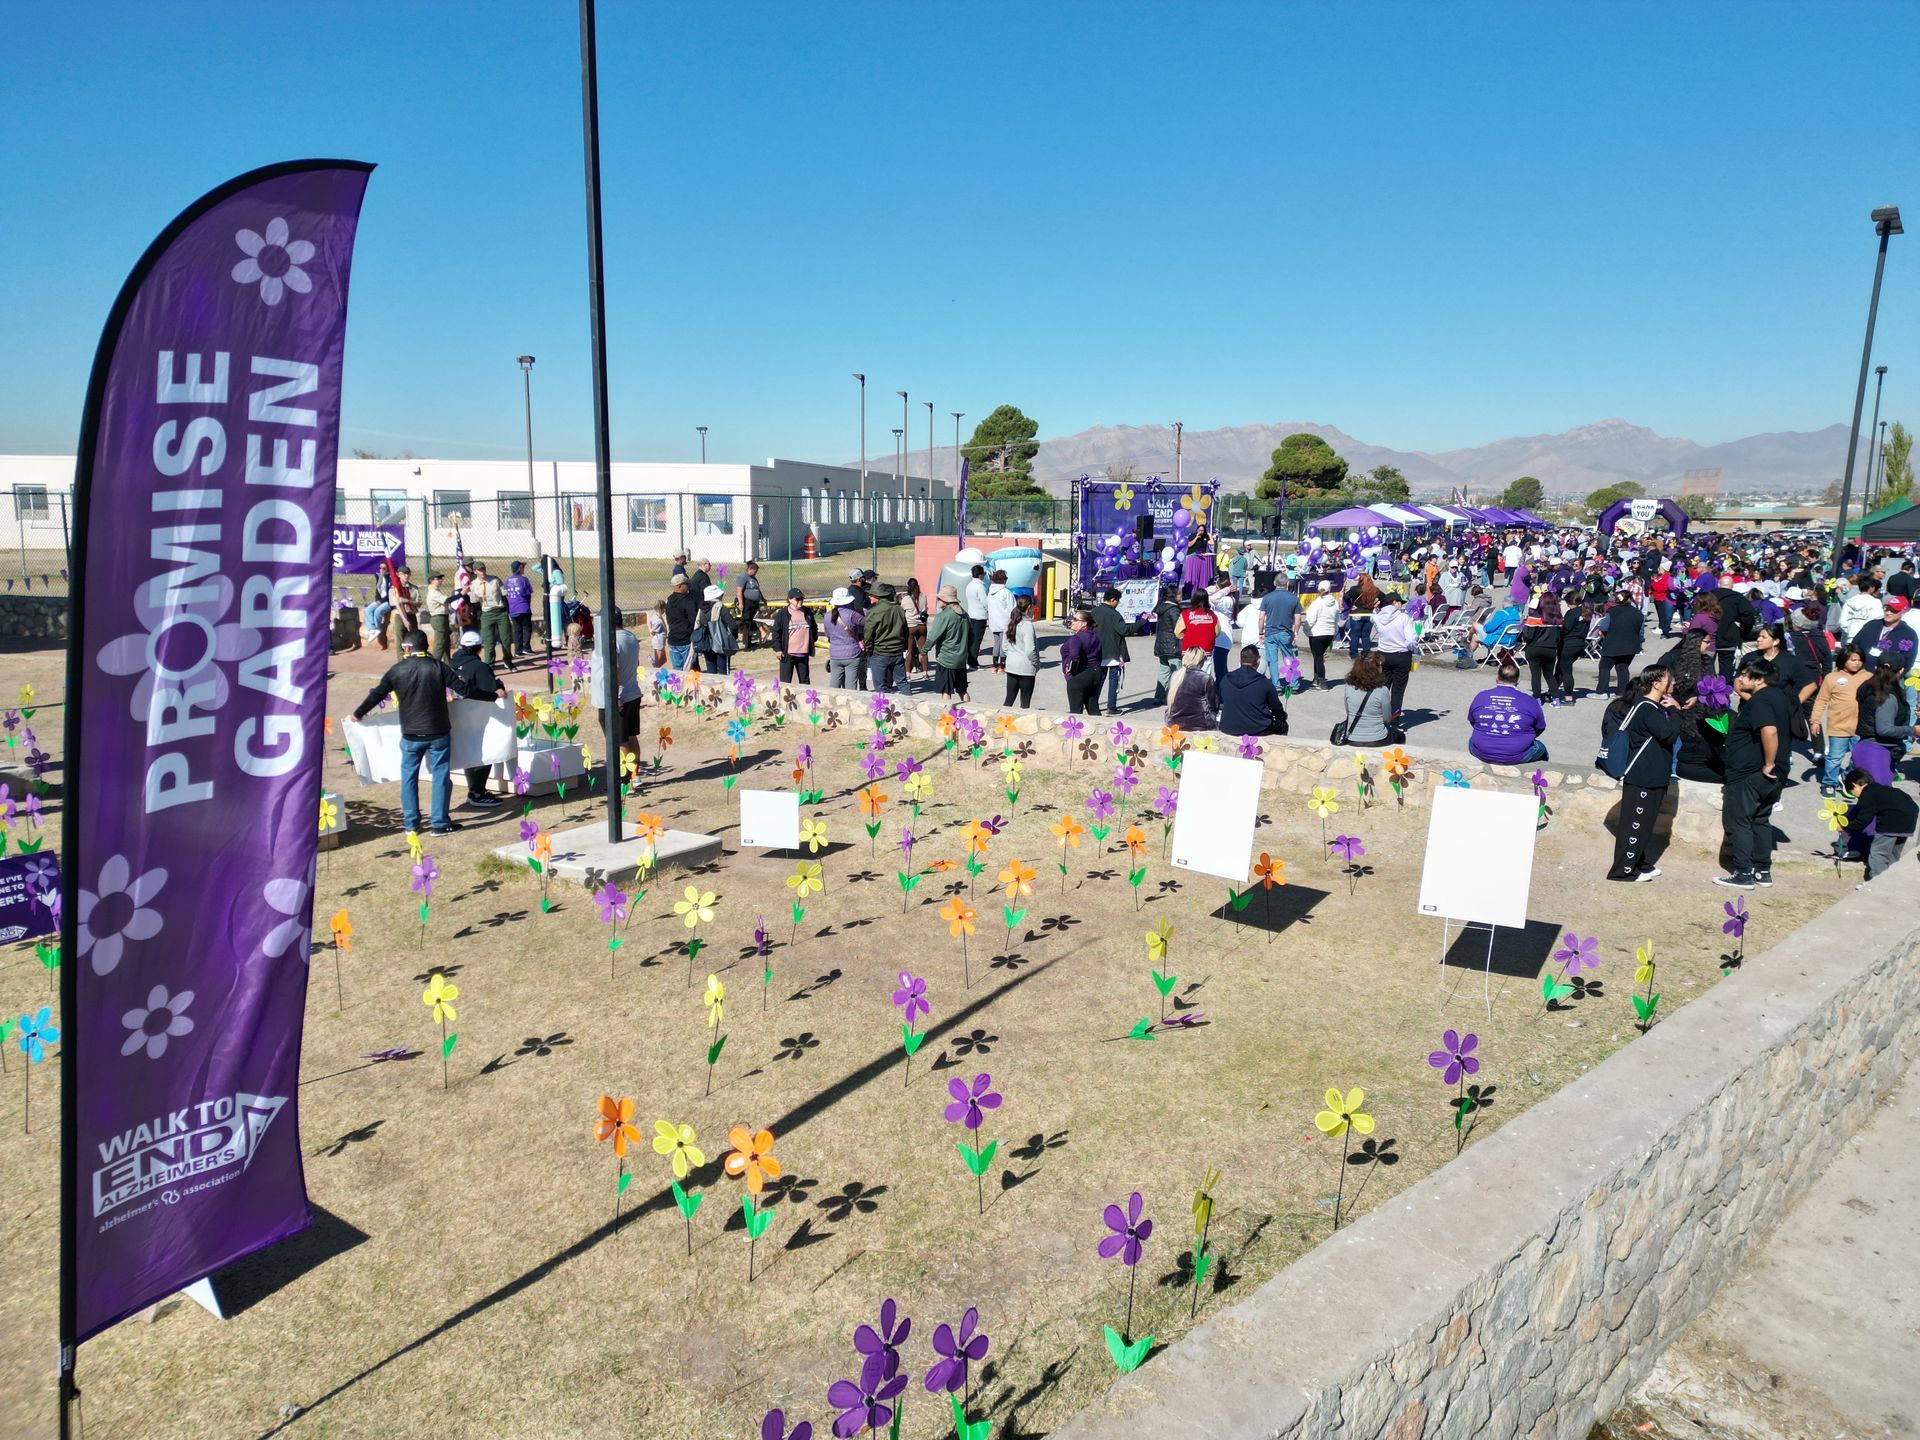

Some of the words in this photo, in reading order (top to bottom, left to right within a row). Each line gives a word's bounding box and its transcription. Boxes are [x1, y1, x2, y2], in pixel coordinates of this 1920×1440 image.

[145, 350, 230, 813] PROMISE
[234, 356, 319, 778] GARDEN
[98, 1108, 190, 1164] WALK
[194, 1096, 233, 1126] TO
[98, 1124, 234, 1195] END
[98, 1199, 159, 1234] alzheimer's
[182, 1169, 241, 1197] association
[100, 1148, 236, 1211] ALZHEIMER'S
